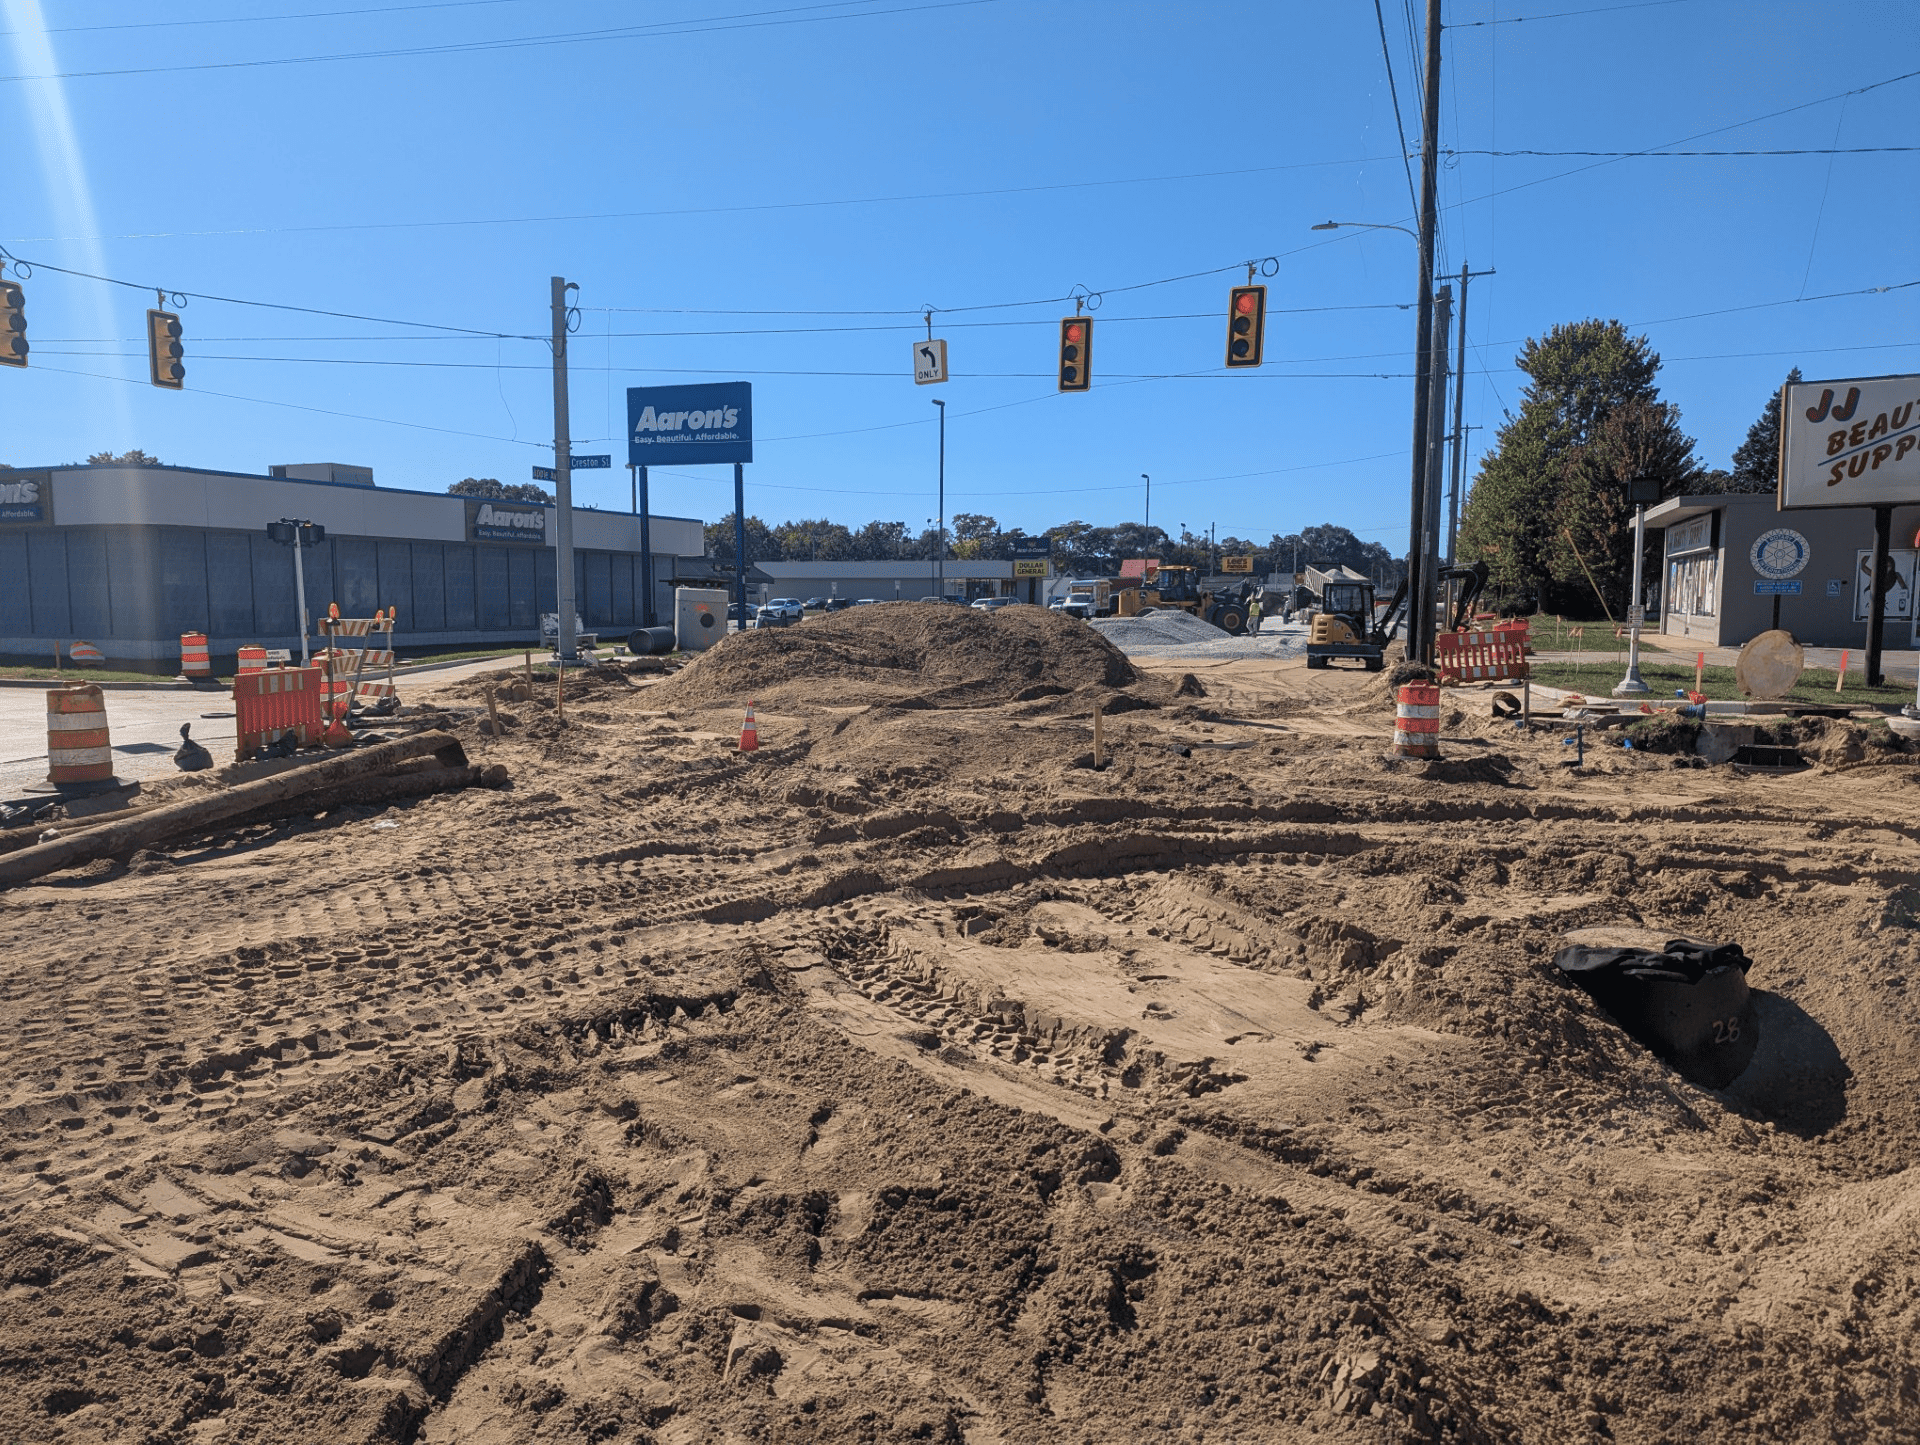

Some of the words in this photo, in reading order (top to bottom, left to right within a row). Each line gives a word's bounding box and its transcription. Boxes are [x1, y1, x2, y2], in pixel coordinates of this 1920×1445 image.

[918, 370, 938, 379] ONLY
[1806, 387, 1861, 423] JJ
[635, 405, 738, 432] Aaron's
[635, 436, 655, 444] Easy.
[656, 434, 694, 443] Beautiful.
[695, 432, 739, 441] Affordable.
[572, 457, 598, 468] Creston
[476, 504, 544, 529] Aaron's
[1712, 1016, 1740, 1043] 28
